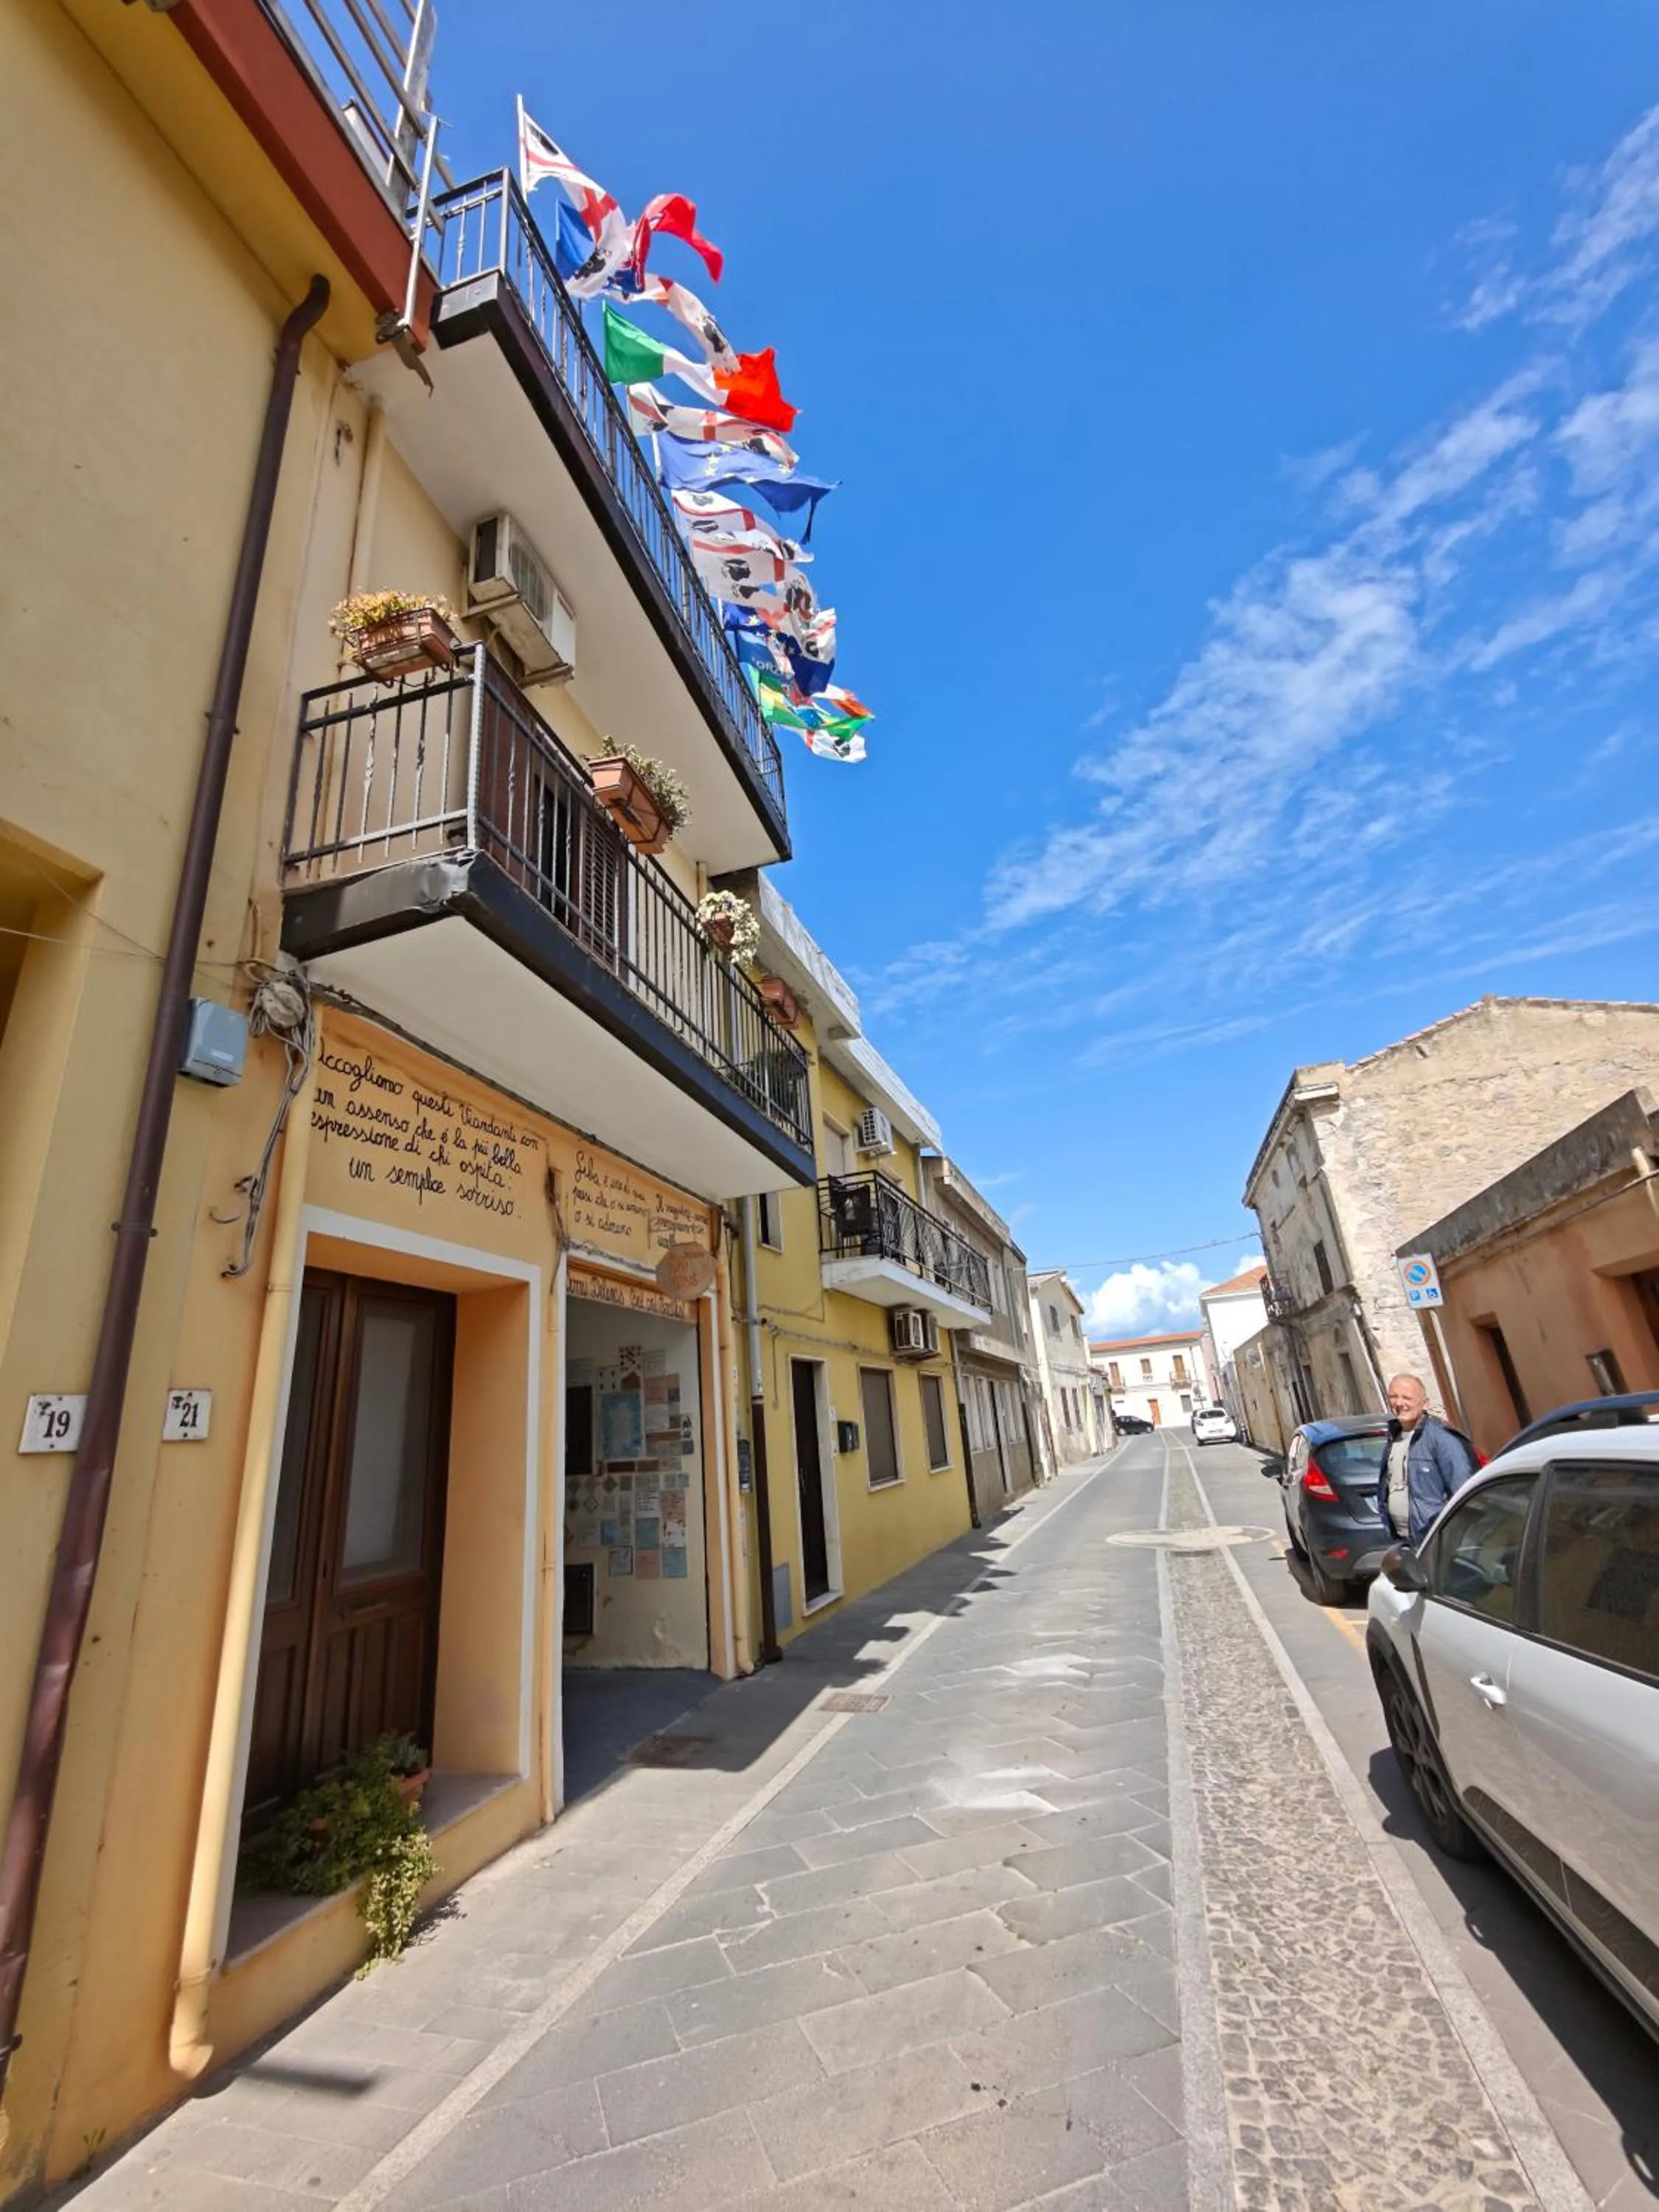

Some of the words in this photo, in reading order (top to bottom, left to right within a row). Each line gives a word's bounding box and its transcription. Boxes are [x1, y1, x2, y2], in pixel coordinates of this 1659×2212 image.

[345, 1100, 409, 1133] assenso
[415, 1117, 435, 1141] che
[453, 1127, 467, 1150] la
[428, 1145, 451, 1166] chi
[349, 1156, 375, 1182] un
[42, 1409, 72, 1439] 19
[179, 1402, 199, 1428] 21
